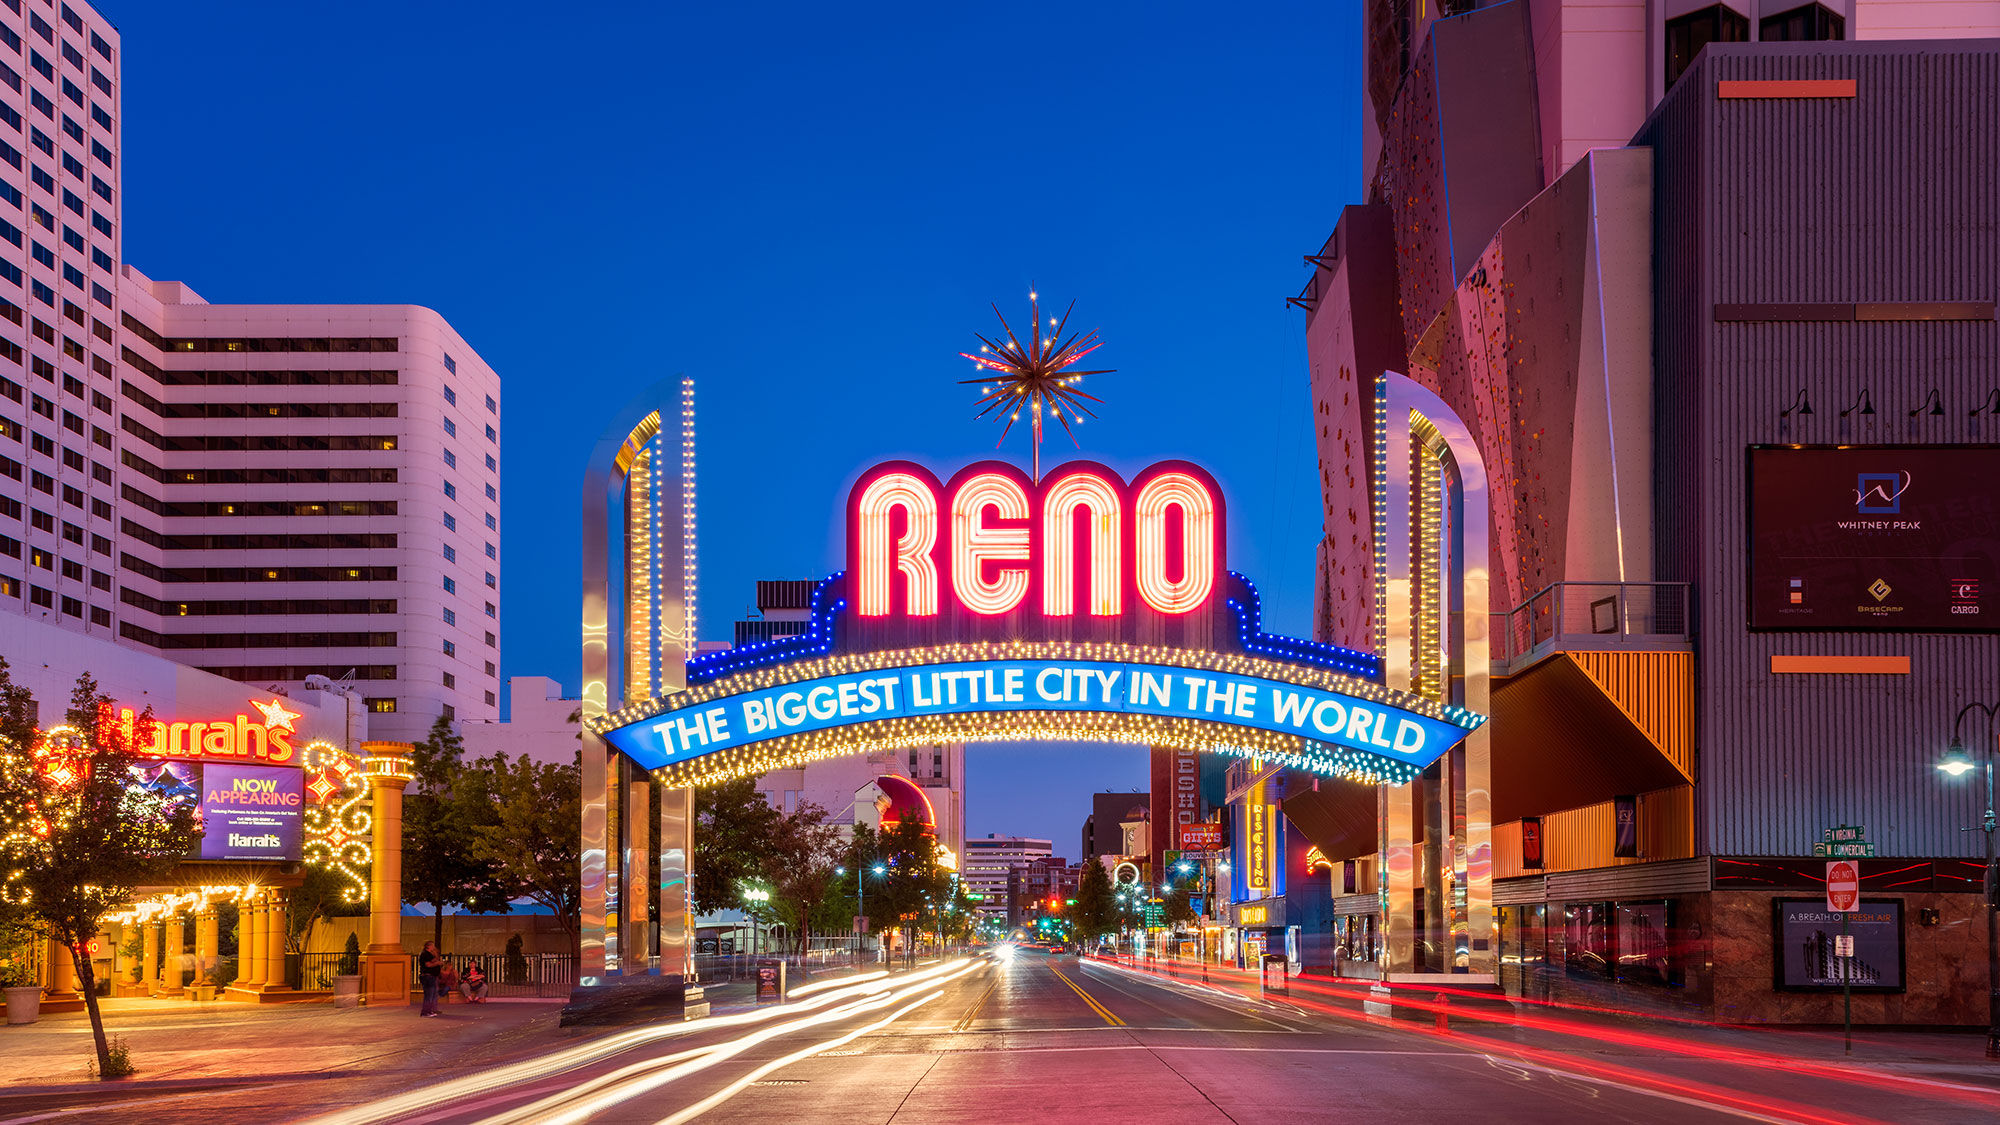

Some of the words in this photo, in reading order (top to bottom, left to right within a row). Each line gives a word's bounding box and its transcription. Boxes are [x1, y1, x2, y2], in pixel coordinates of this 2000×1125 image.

[1838, 521, 1890, 530] WHITNEY
[1893, 521, 1921, 530] PEAK
[858, 473, 1214, 616] RENO
[1951, 606, 1980, 614] CARGO
[653, 707, 730, 755] THE
[742, 676, 900, 734] BIGGEST
[911, 669, 1024, 707] LITTLE
[1035, 667, 1122, 703] CITY
[1129, 671, 1172, 708] IN
[1183, 677, 1257, 718] THE
[1272, 689, 1426, 755] WORLD
[233, 778, 277, 793] NOW
[206, 790, 300, 806] APPEARING
[1183, 832, 1221, 843] GIFTS
[1836, 828, 1857, 841] VIRGINIA
[1834, 843, 1867, 856] COMMERCIAL
[1252, 832, 1264, 886] CASINO
[1831, 871, 1839, 880] DO
[1842, 870, 1853, 879] NOT
[1834, 894, 1852, 904] ENTER
[1789, 913, 1796, 921] A
[1798, 913, 1831, 921] BREATH
[1848, 913, 1874, 921] FRESH
[1877, 913, 1892, 921] AIR
